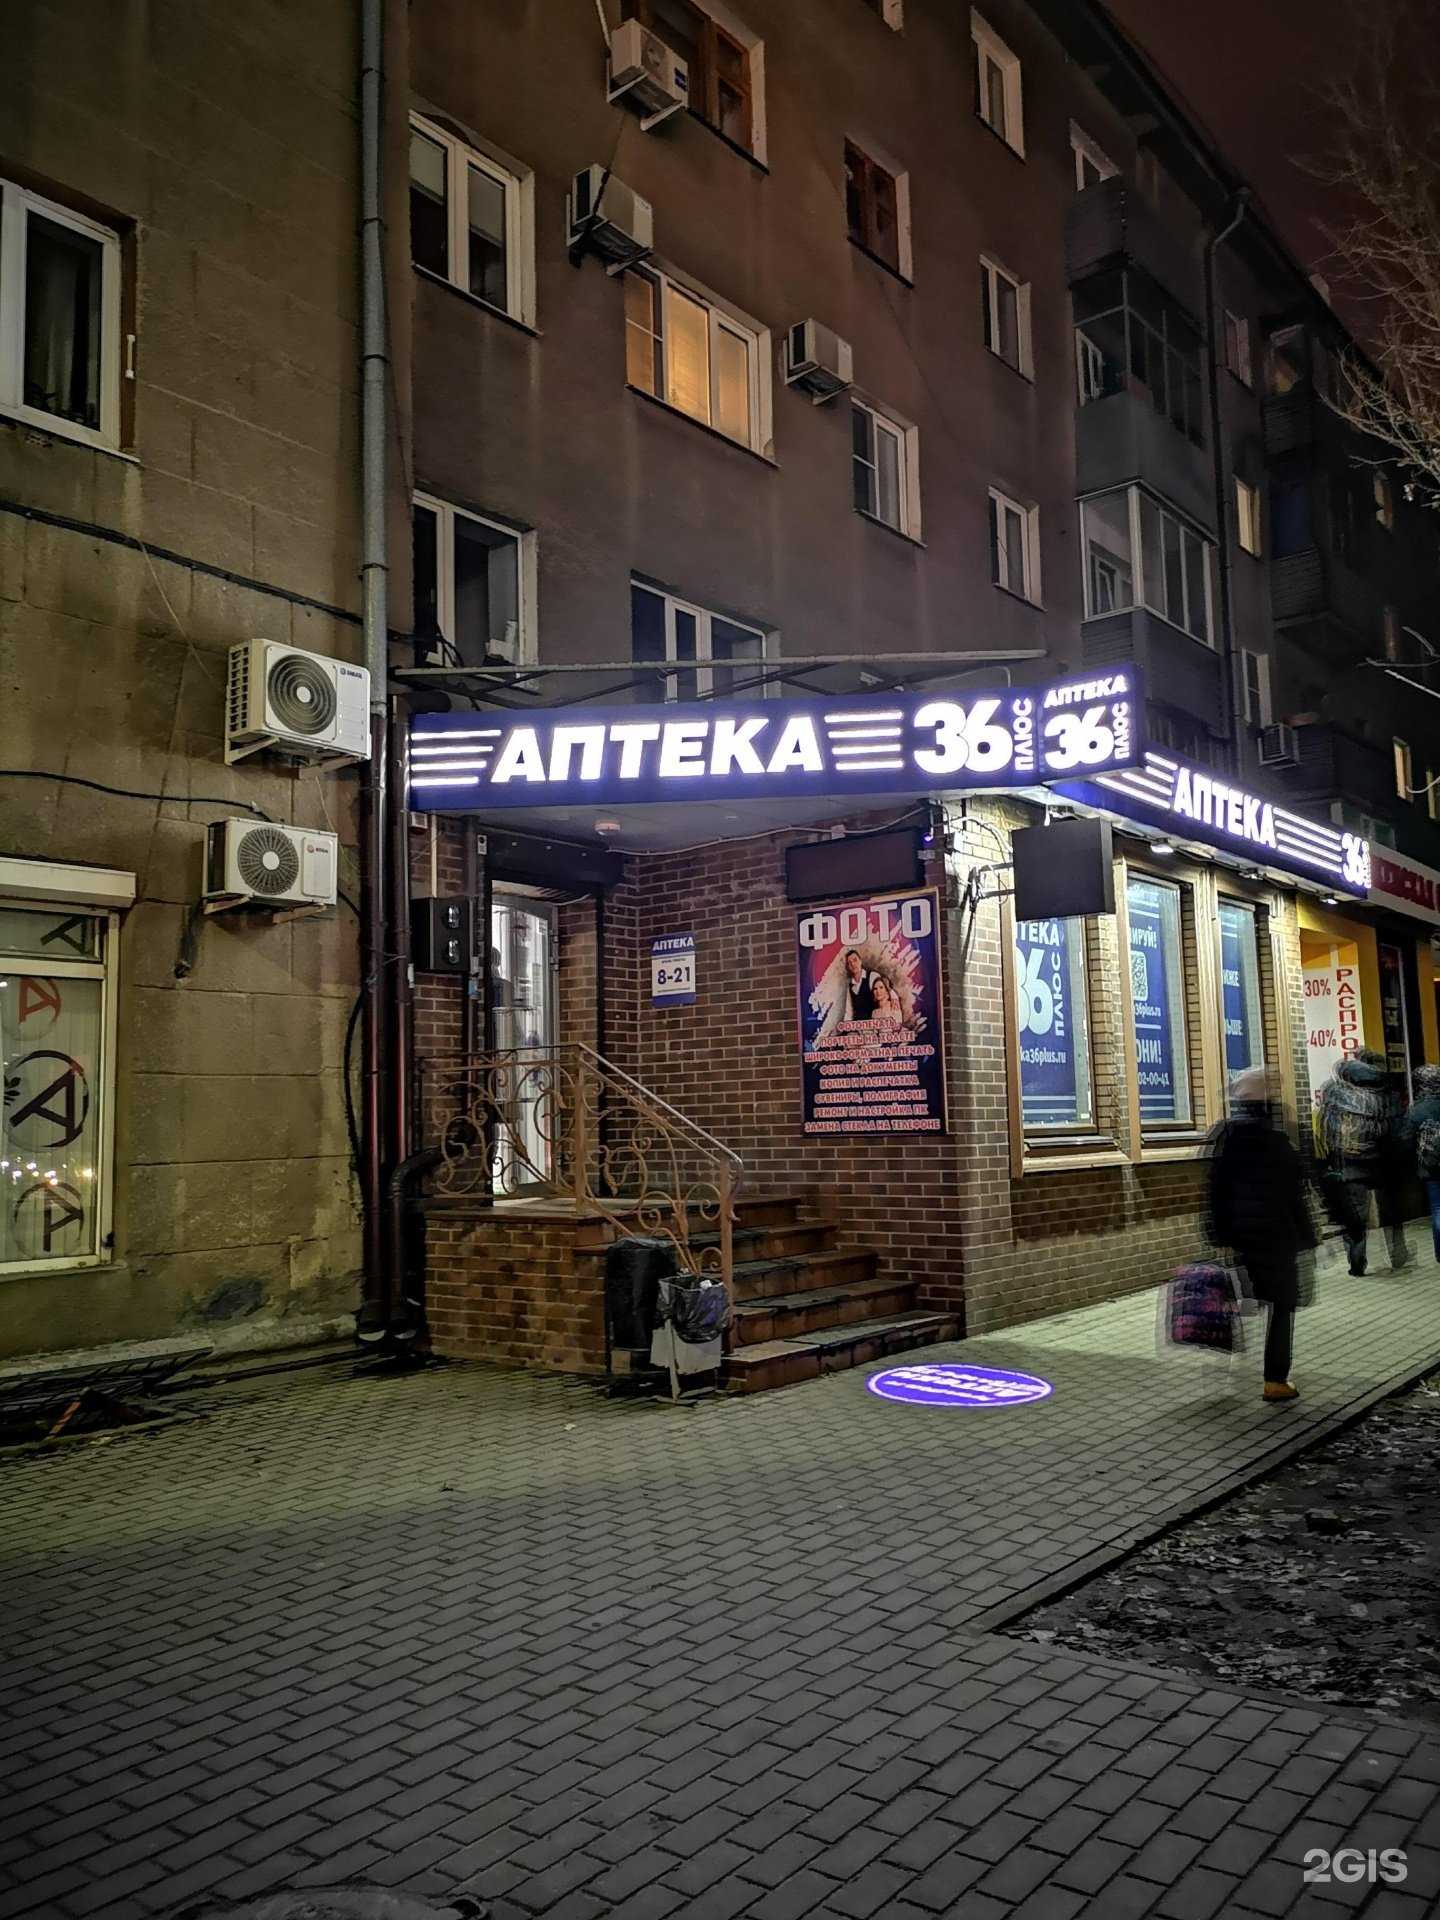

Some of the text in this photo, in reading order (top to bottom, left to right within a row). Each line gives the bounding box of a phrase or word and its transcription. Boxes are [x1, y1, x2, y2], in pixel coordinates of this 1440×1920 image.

[1044, 674, 1127, 709] АПТЕКА
[491, 699, 1013, 784] АПТЕКА 36
[1013, 698, 1033, 771] ПЛЮС
[1044, 705, 1114, 770] 36
[1113, 702, 1129, 759] ПЛЮС
[1172, 767, 1277, 849] АПТЕКА
[799, 898, 932, 950] ФОТО
[1016, 921, 1060, 946] ТЕКА
[652, 937, 695, 951] АПТЕКА
[1131, 926, 1157, 948] ИРУЙ!
[657, 966, 690, 985] 8-21
[1051, 952, 1065, 1036] ПЛЮС
[1135, 1003, 1161, 1018] 36plus.ru
[804, 1045, 935, 1063] ШИРОКОФОРМАТНАЯ ПЕЧАТЬ
[1019, 1047, 1067, 1066] ka36plus.ru
[1136, 1039, 1162, 1064] ОНИ!
[820, 1064, 845, 1075] ФОТО
[860, 1060, 918, 1074] ДОКУМЕНТЫ
[804, 1121, 841, 1133] ЗАМЕНА
[891, 1118, 941, 1130] ТЕЛЕФОНЕ
[813, 1107, 848, 1119] РЕМОНТ
